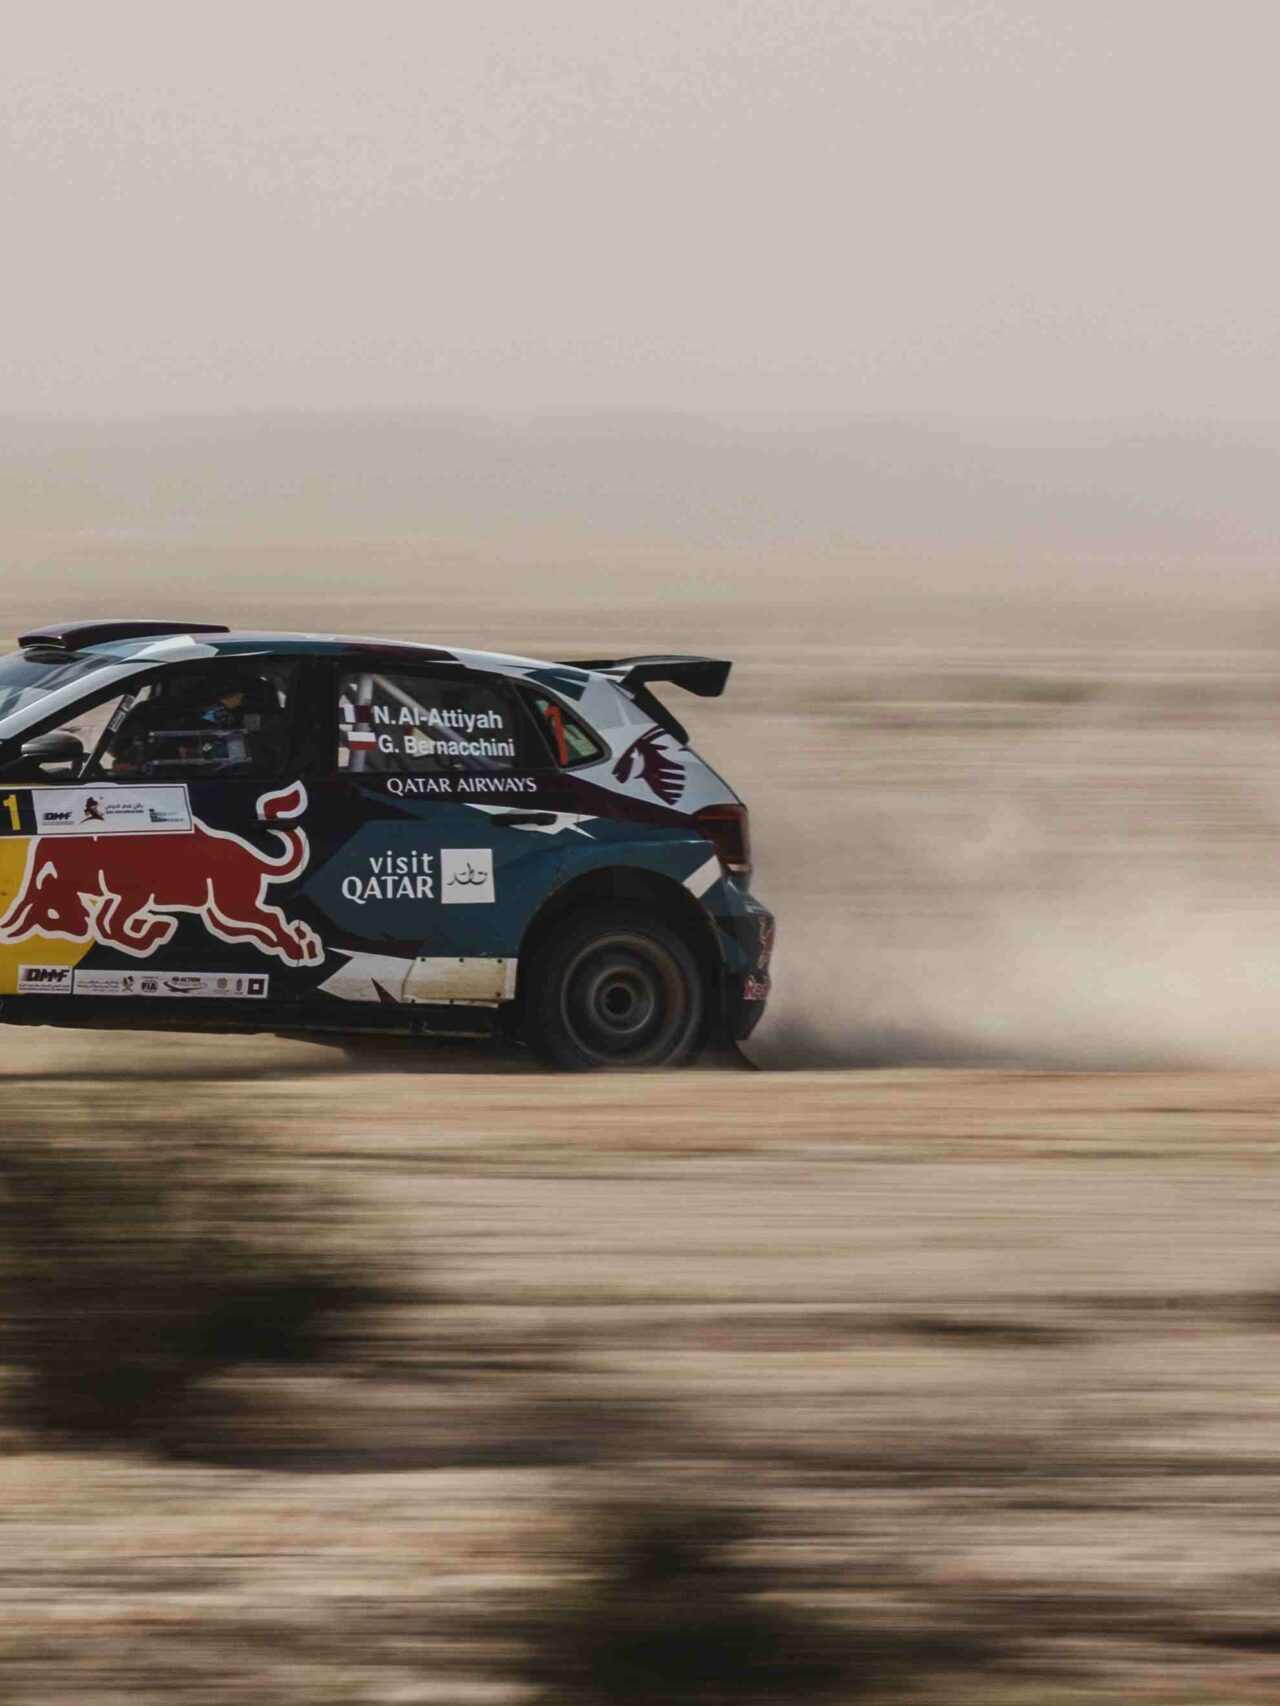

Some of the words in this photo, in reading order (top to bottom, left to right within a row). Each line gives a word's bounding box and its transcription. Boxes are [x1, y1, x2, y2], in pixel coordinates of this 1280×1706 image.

[378, 734, 399, 753] G.
[404, 735, 515, 757] Bernacchini
[387, 778, 452, 796] QATAR
[457, 777, 537, 793] AIRWAYS
[2, 794, 22, 831] 1
[369, 850, 434, 874] visit
[342, 876, 434, 904] QATAR
